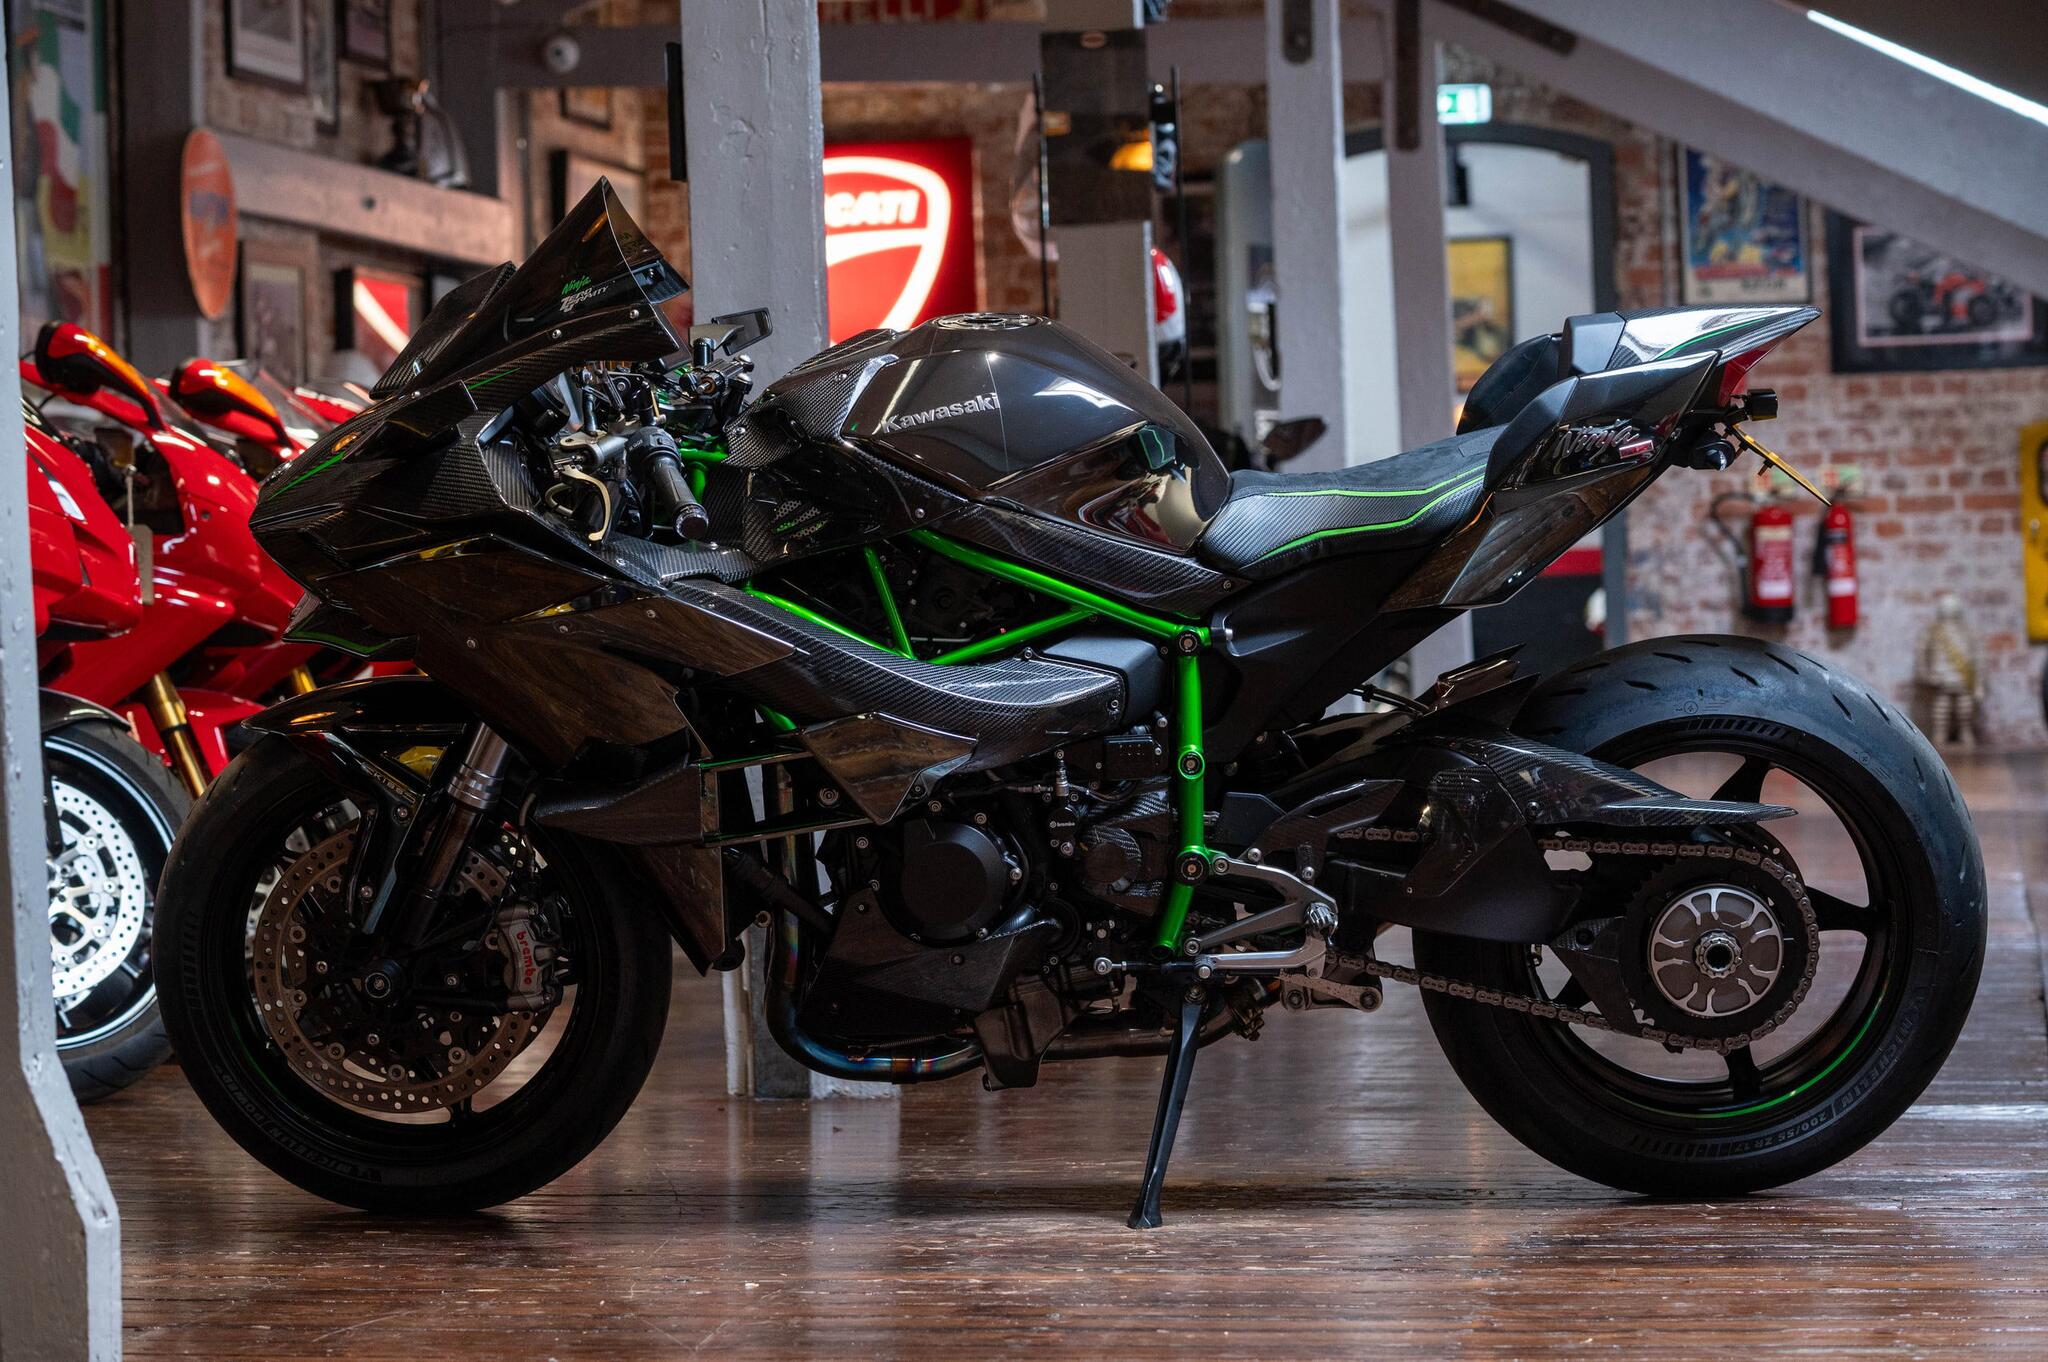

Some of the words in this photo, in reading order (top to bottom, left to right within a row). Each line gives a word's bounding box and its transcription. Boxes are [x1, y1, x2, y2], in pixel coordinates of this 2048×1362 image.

[825, 190, 919, 228] CATI
[881, 392, 1000, 434] Kawasaki
[516, 930, 537, 985] brembo
